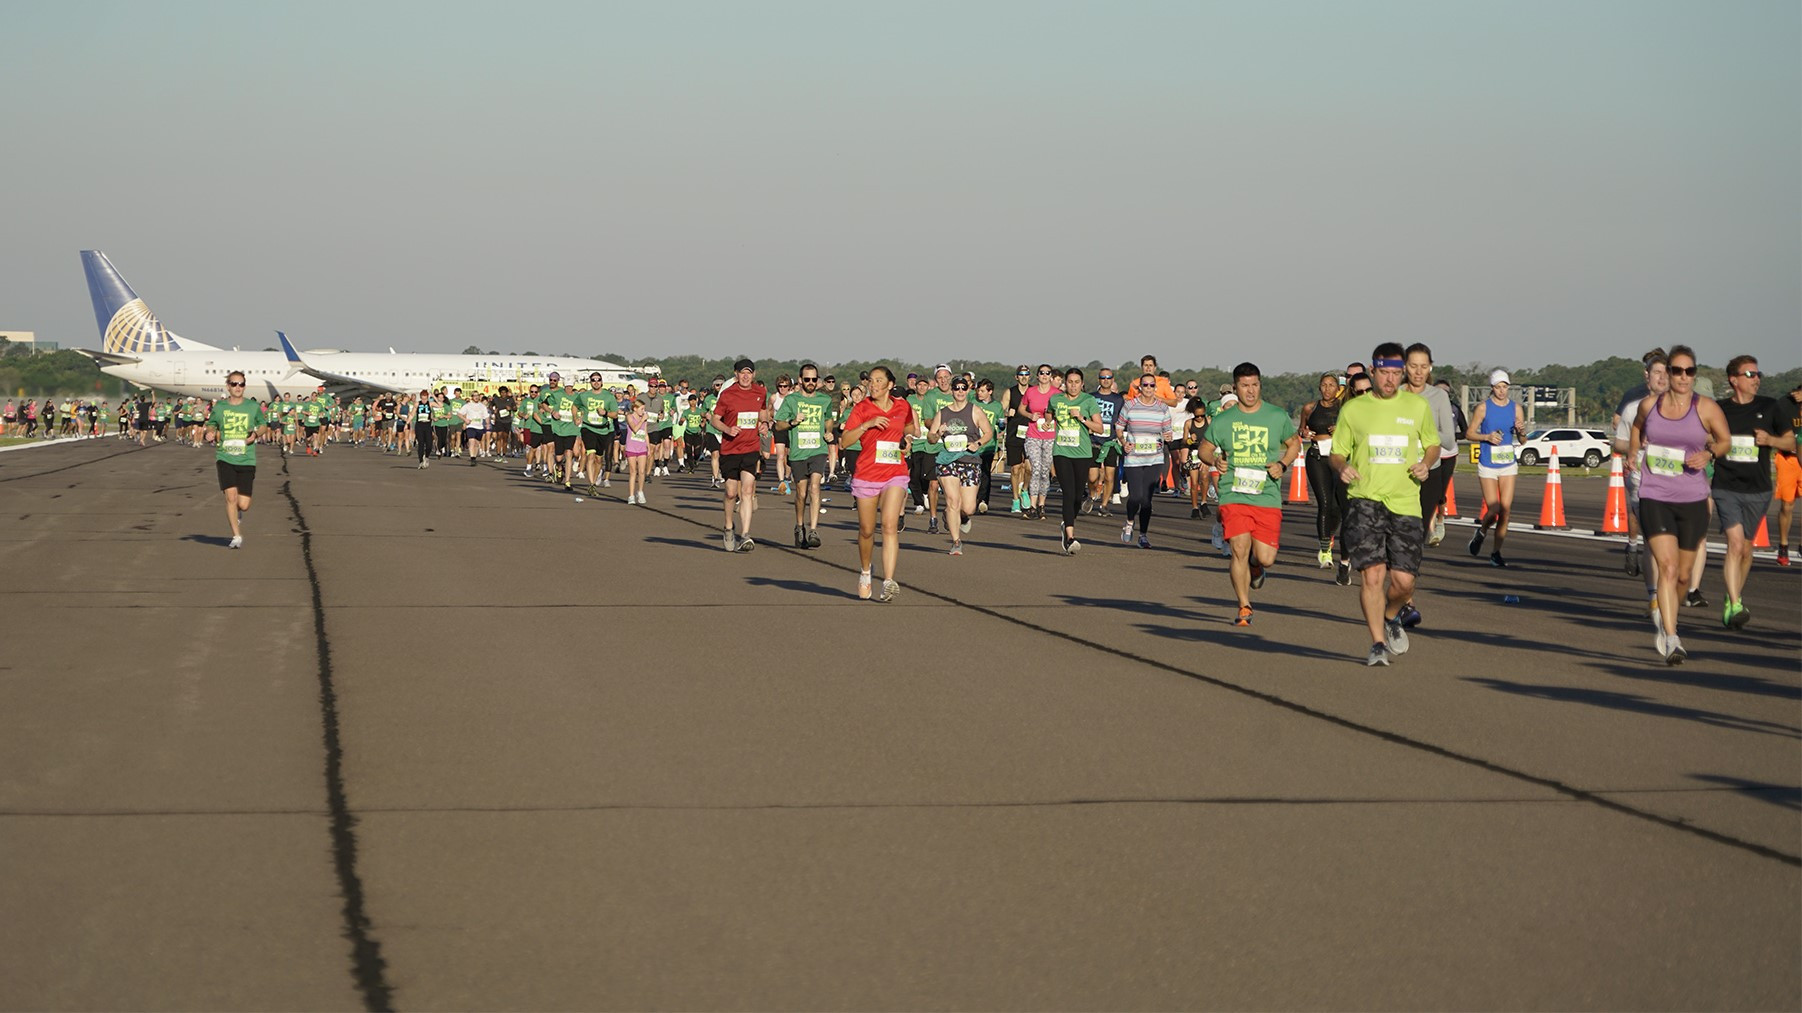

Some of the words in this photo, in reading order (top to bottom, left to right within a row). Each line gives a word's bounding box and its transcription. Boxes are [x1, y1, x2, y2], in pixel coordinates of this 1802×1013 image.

[483, 384, 489, 394] 4
[1234, 430, 1268, 454] 5K
[882, 451, 898, 459] 864
[1375, 447, 1402, 457] 1878
[1731, 447, 1752, 456] 470
[1655, 458, 1675, 469] 276
[1238, 478, 1260, 489] 1627
